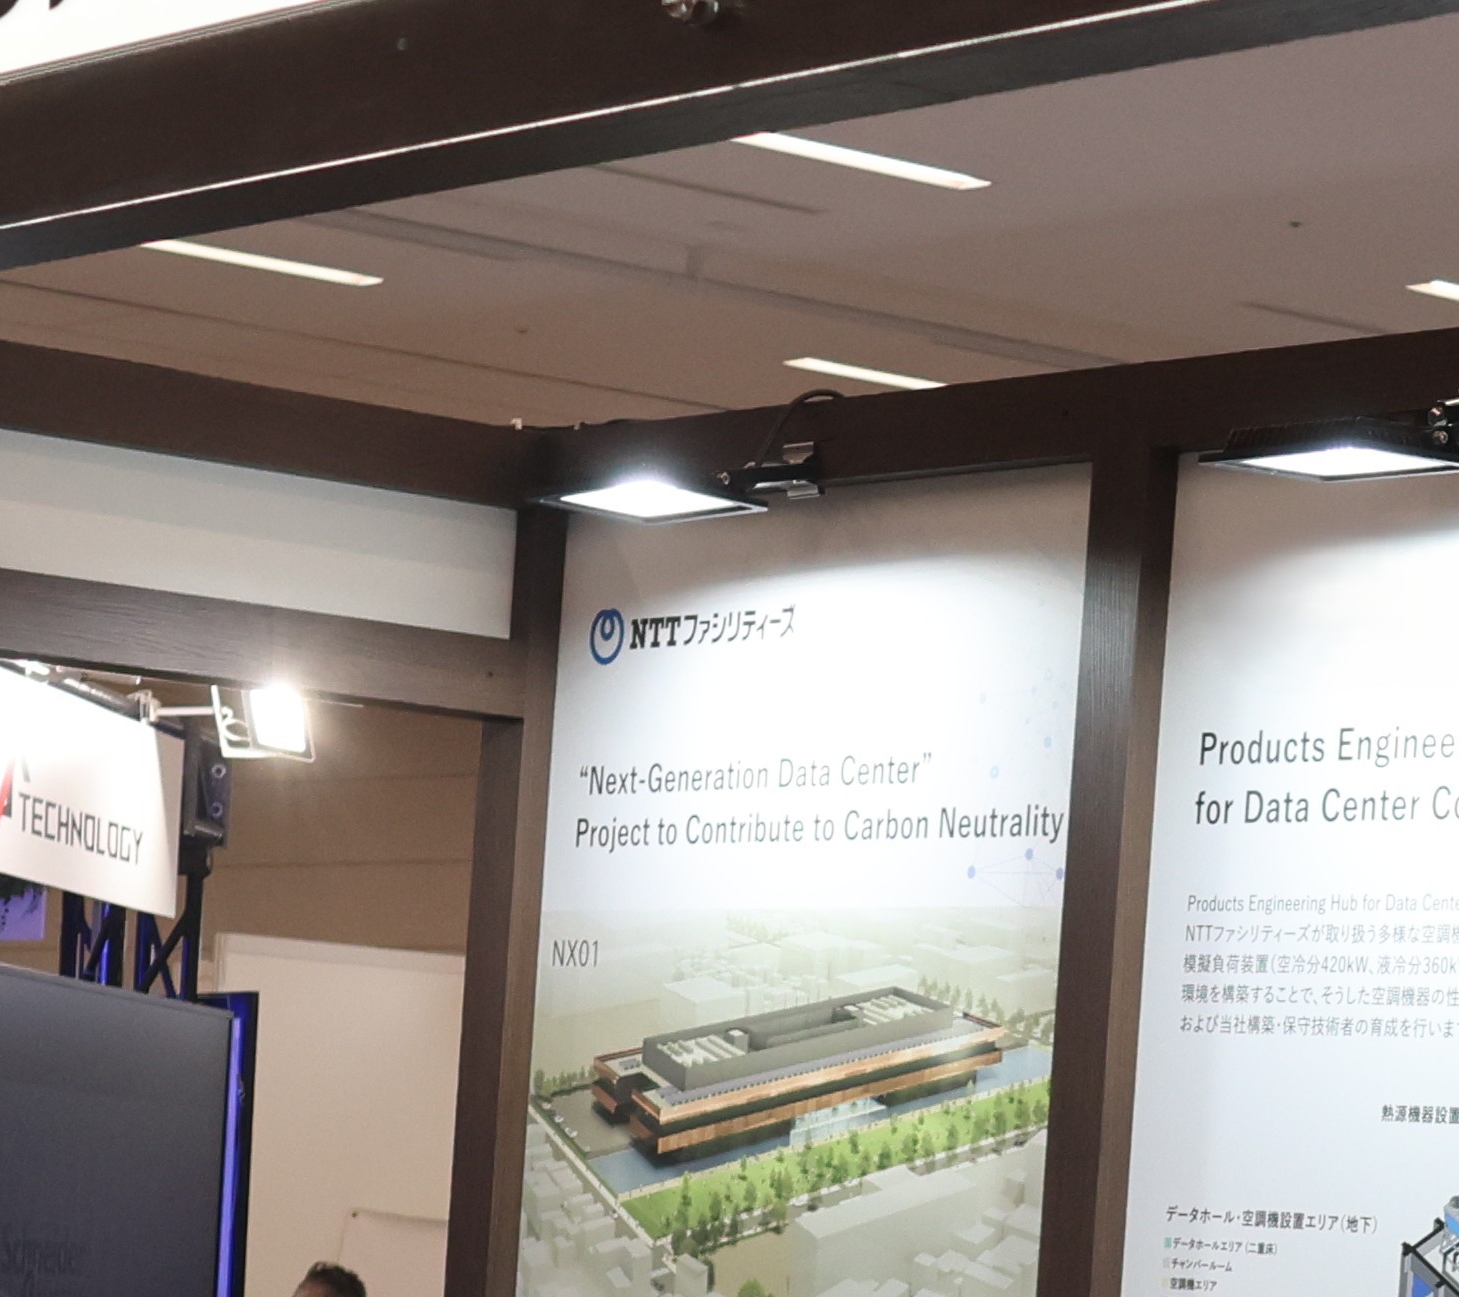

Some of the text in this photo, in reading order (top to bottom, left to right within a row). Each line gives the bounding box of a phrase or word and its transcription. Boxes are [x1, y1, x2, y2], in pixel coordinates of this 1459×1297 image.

[629, 604, 796, 650] NTTファシリティーズ
[1199, 729, 1326, 766] Products
[778, 758, 831, 789] Data
[1195, 789, 1235, 826] for
[1243, 789, 1310, 825] Data
[1321, 785, 1420, 823] Center
[18, 792, 143, 866] TECHNOLOGY
[575, 803, 1065, 852] Project to Contribute to Carbon Neutrality
[1187, 894, 1245, 914] Products
[1248, 894, 1327, 915] Engineering
[1330, 894, 1358, 912] Hub
[1361, 894, 1381, 912] for
[1385, 894, 1419, 912] Data
[551, 940, 599, 968] NX01
